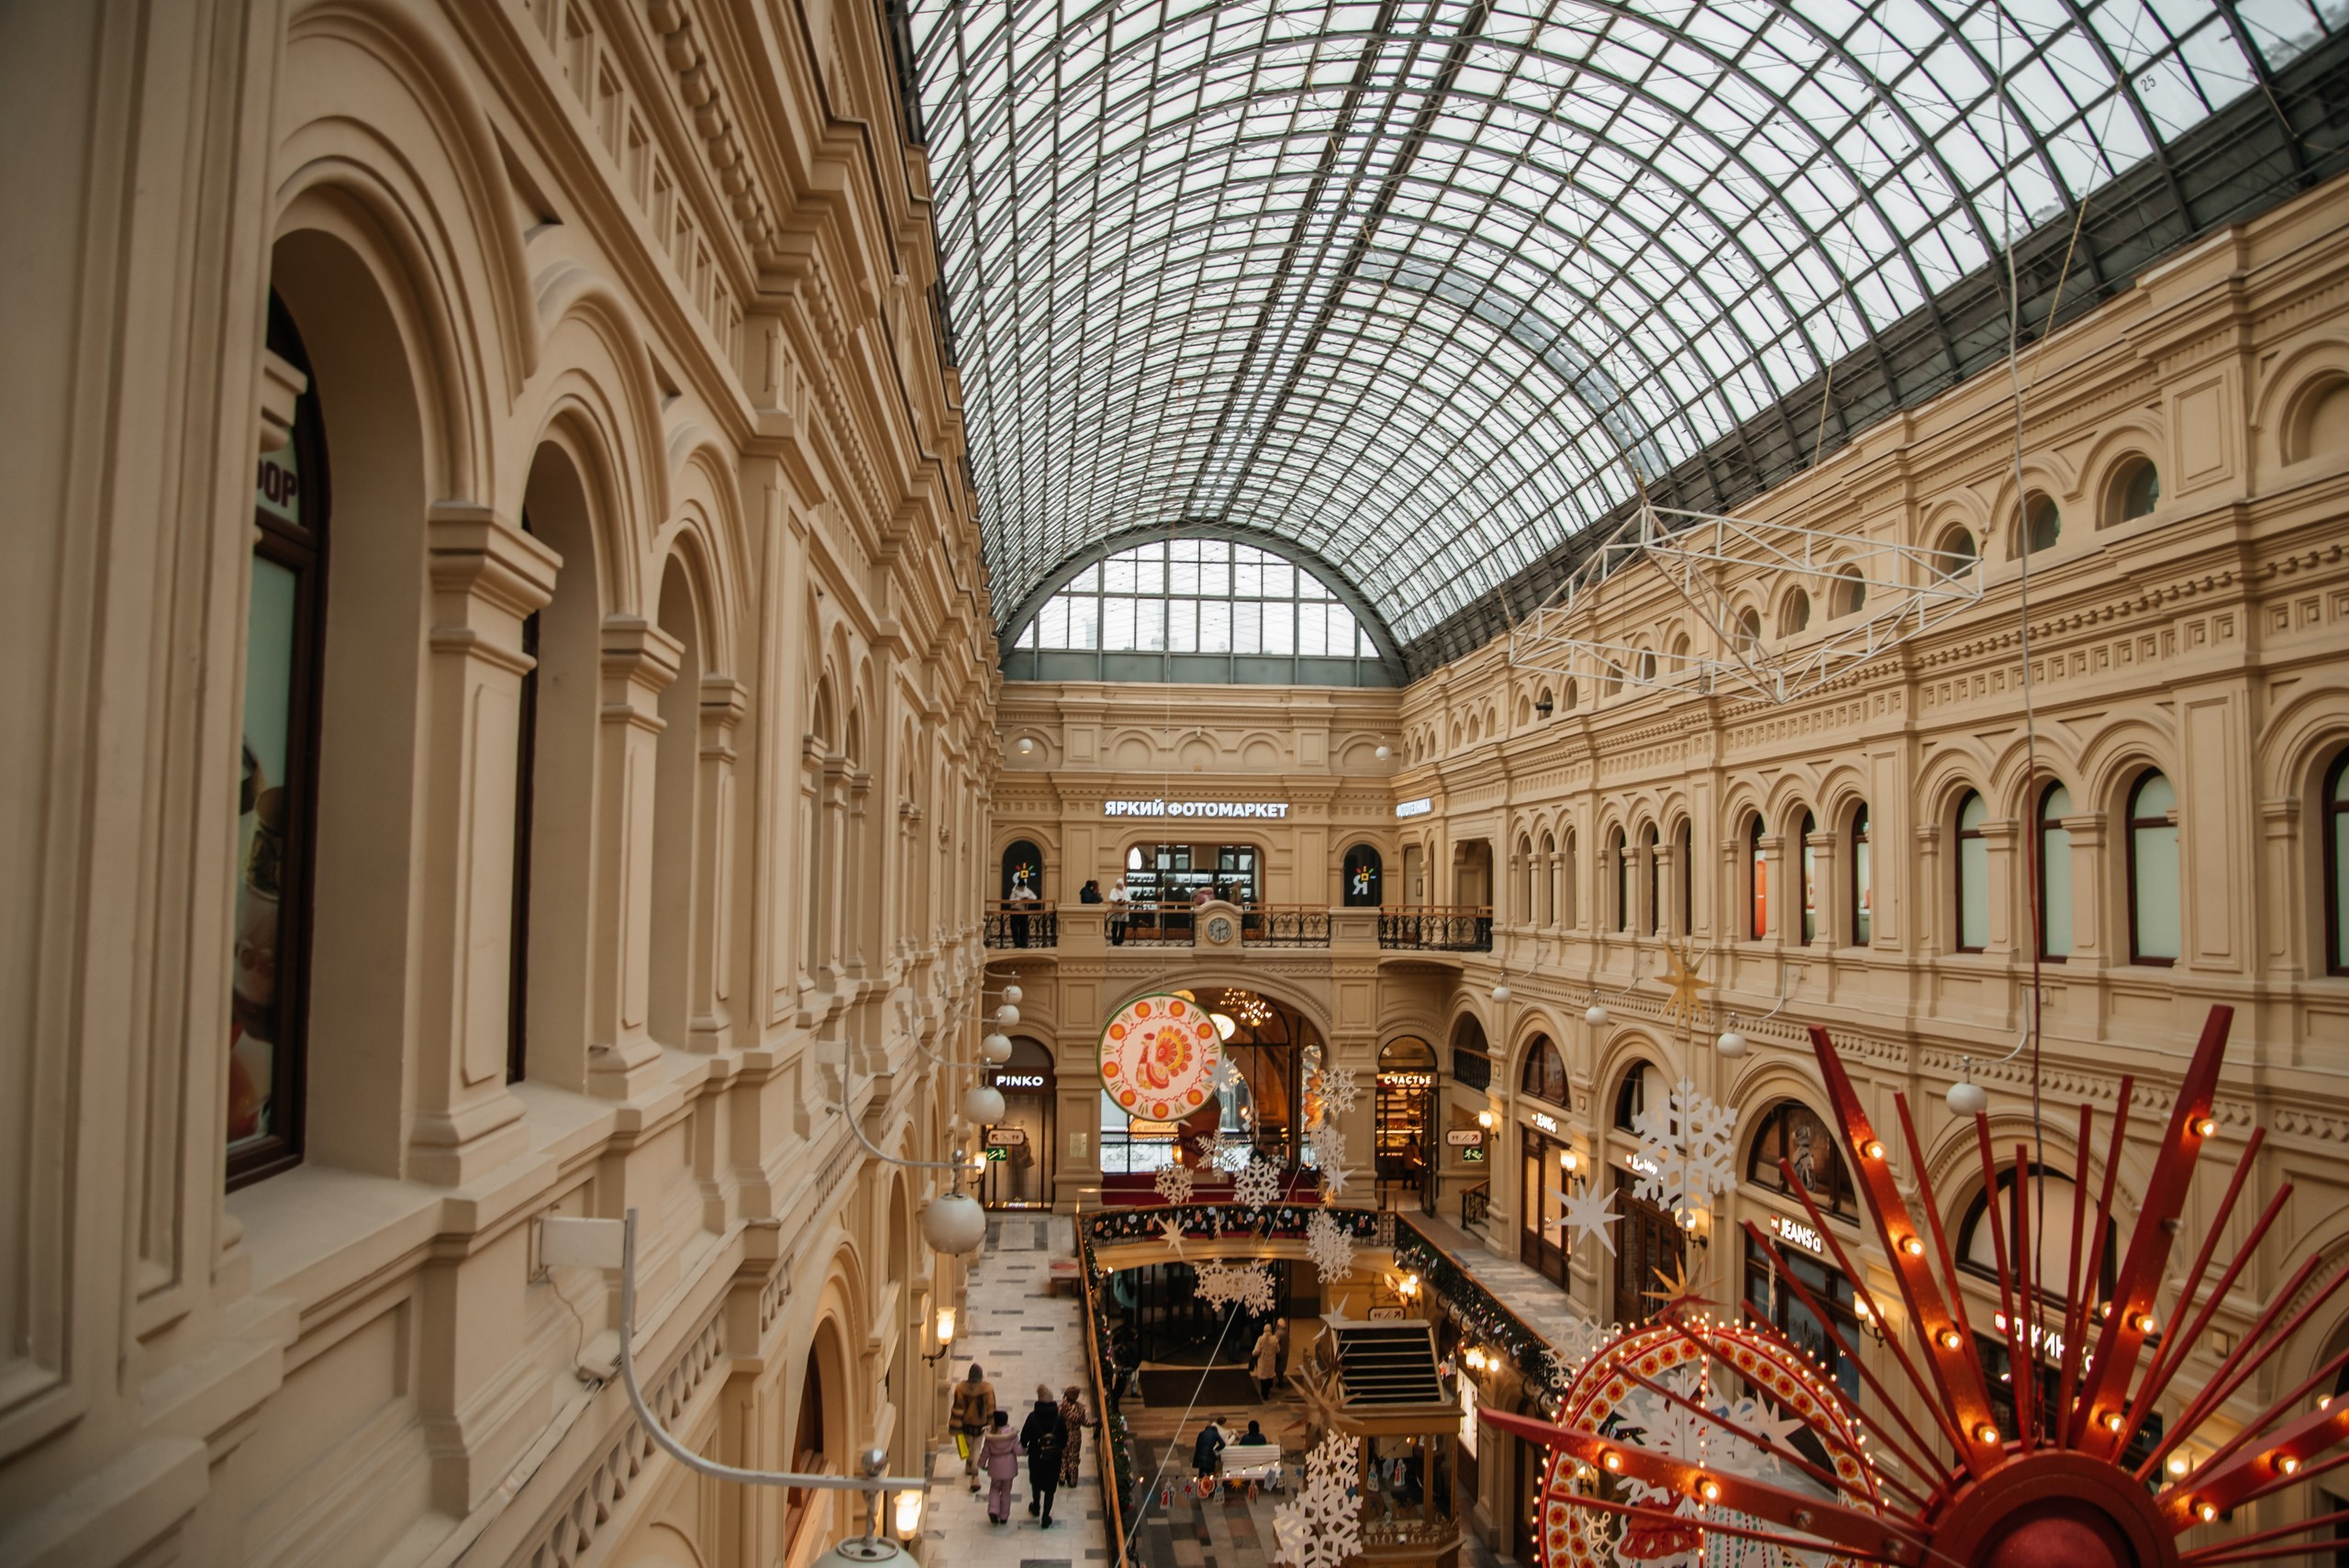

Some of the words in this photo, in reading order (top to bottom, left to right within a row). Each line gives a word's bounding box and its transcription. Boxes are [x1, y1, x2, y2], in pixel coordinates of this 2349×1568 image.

[2141, 74, 2156, 93] 25
[1105, 799, 1164, 816] ЯРКИЙ
[1167, 802, 1288, 817] ФОТОМАРКЕТ
[996, 1075, 1044, 1086] PINKO
[1384, 1075, 1431, 1084] СЧАСТЬЕ
